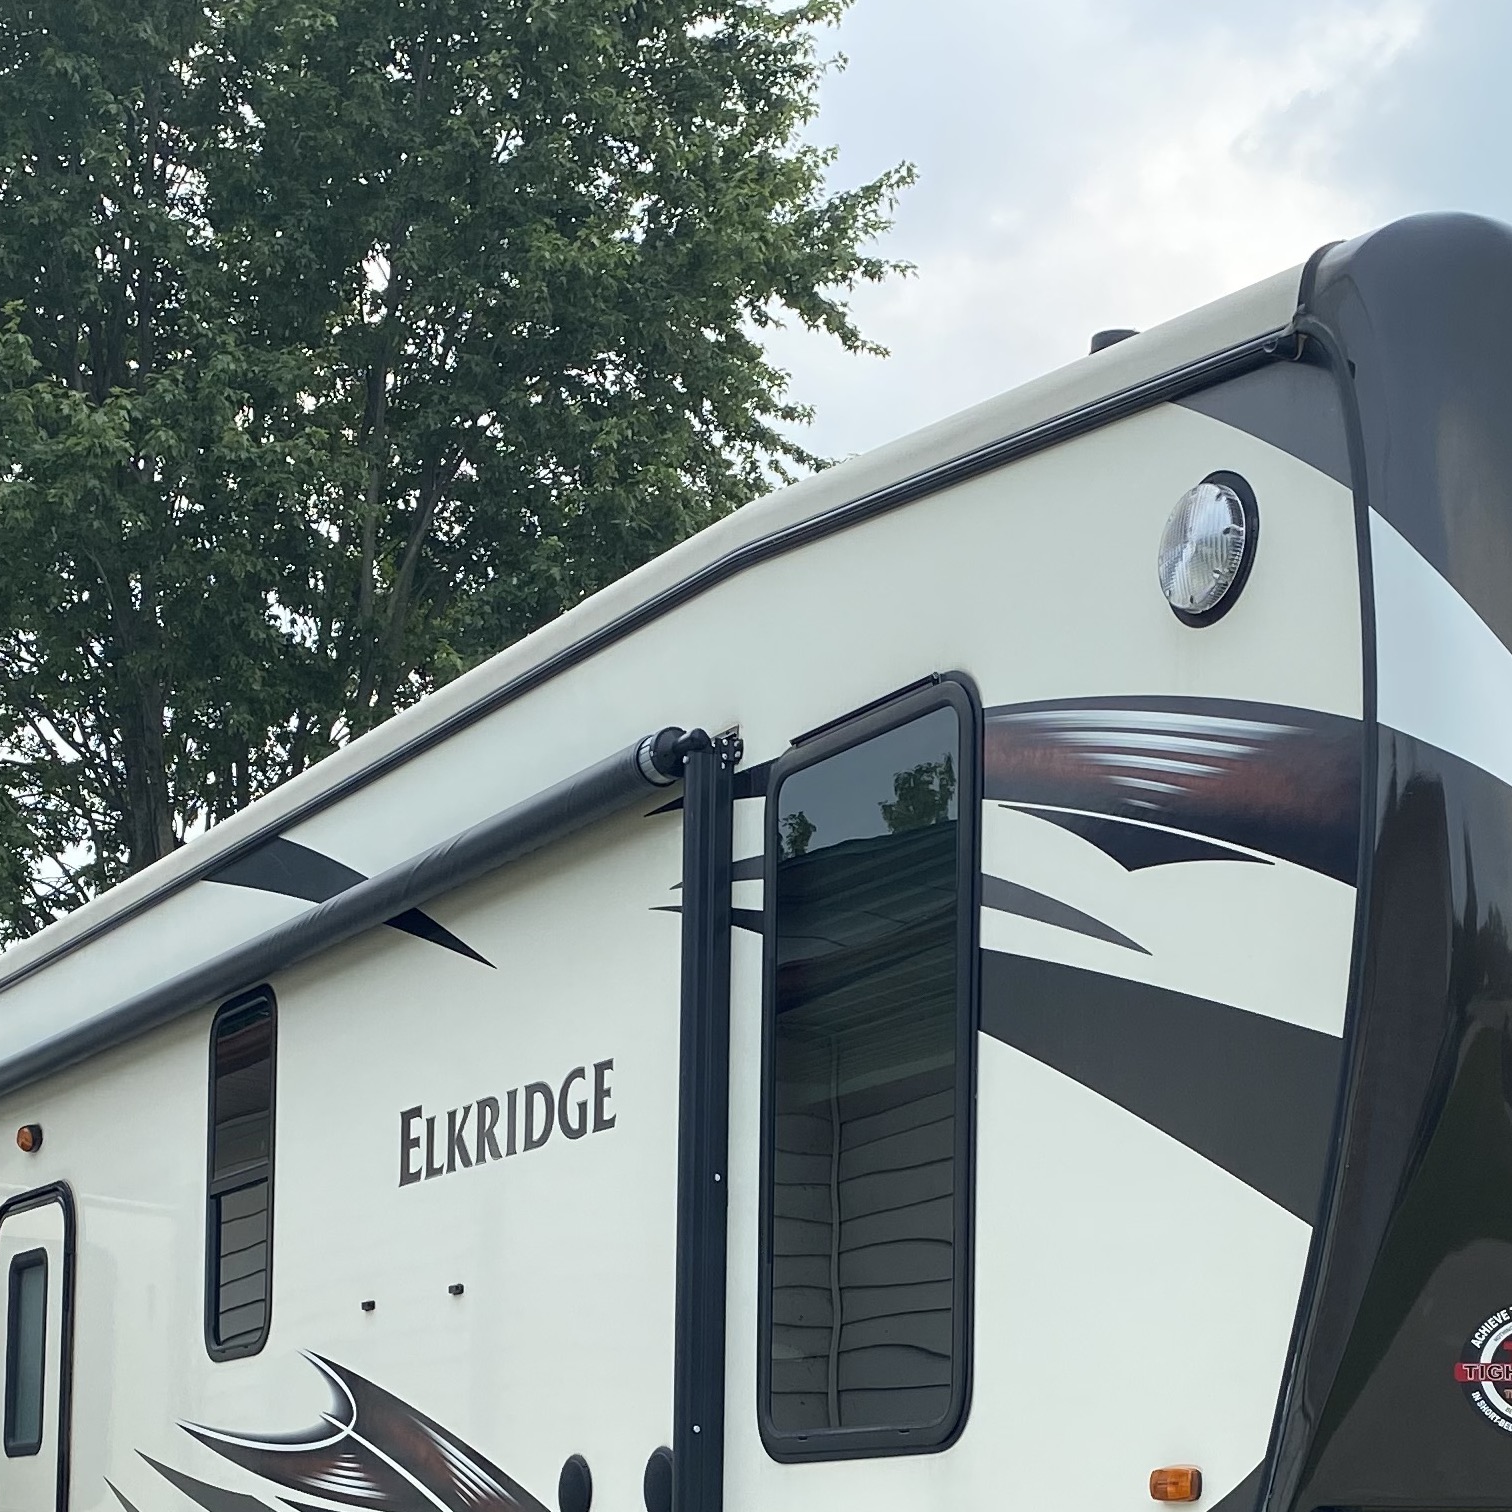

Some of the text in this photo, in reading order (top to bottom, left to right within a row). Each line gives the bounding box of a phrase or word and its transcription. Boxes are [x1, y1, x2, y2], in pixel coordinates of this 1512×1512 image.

[398, 1057, 617, 1188] ELKRIDGE
[1470, 1309, 1511, 1349] ACHIEVE
[1471, 1391, 1483, 1402] IN
